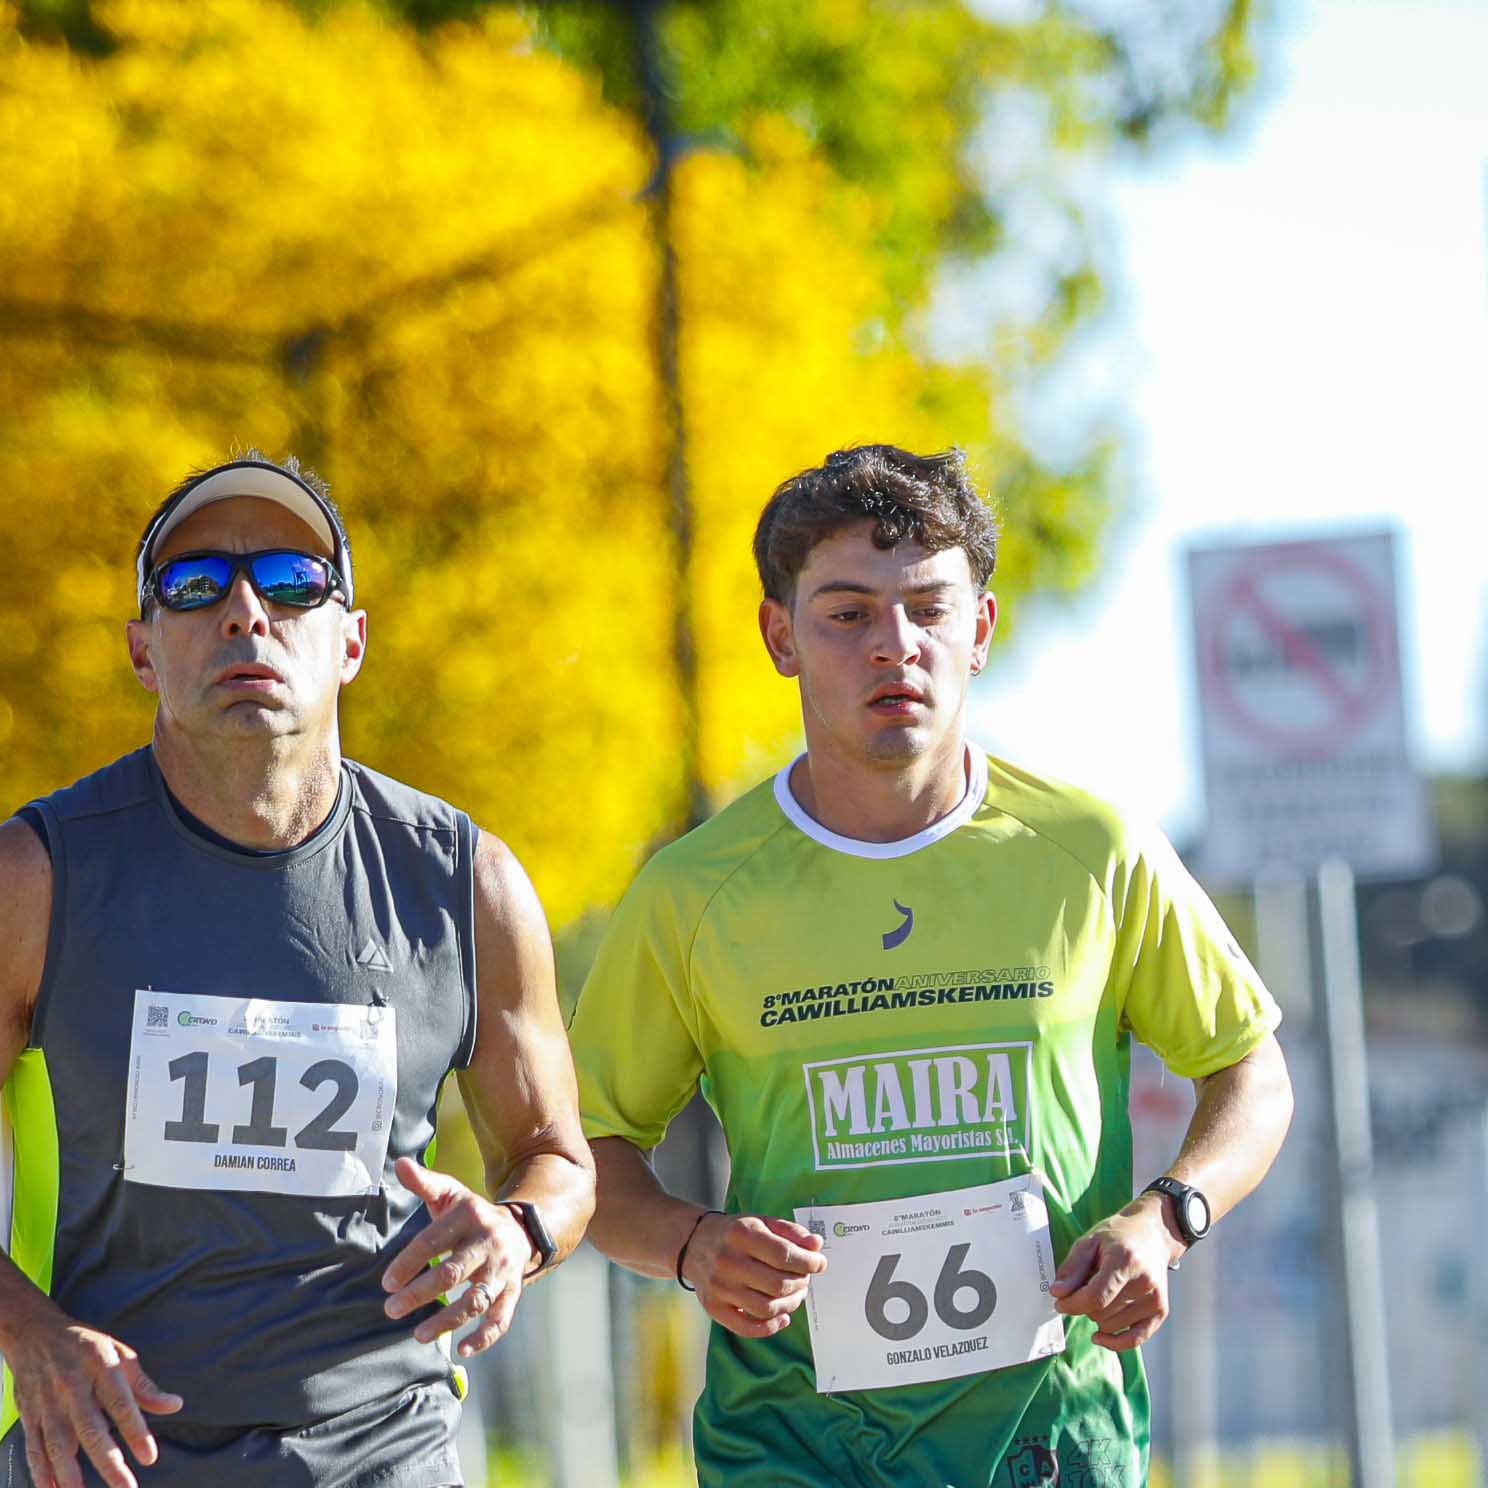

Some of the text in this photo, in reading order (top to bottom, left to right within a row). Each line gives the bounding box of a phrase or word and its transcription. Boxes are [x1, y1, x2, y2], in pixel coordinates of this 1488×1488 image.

[760, 981, 1054, 1027] CAWILLIAMSKEMMIS
[164, 1051, 359, 1151] 112
[819, 1053, 1017, 1137] MAIRA
[214, 1154, 296, 1172] DAMIAN CORREA
[827, 1137, 906, 1160] Almacenes
[911, 1128, 992, 1153] Mayoristas
[865, 1243, 997, 1341] 66
[887, 1336, 989, 1365] GONZALO VELAZQUEZ
